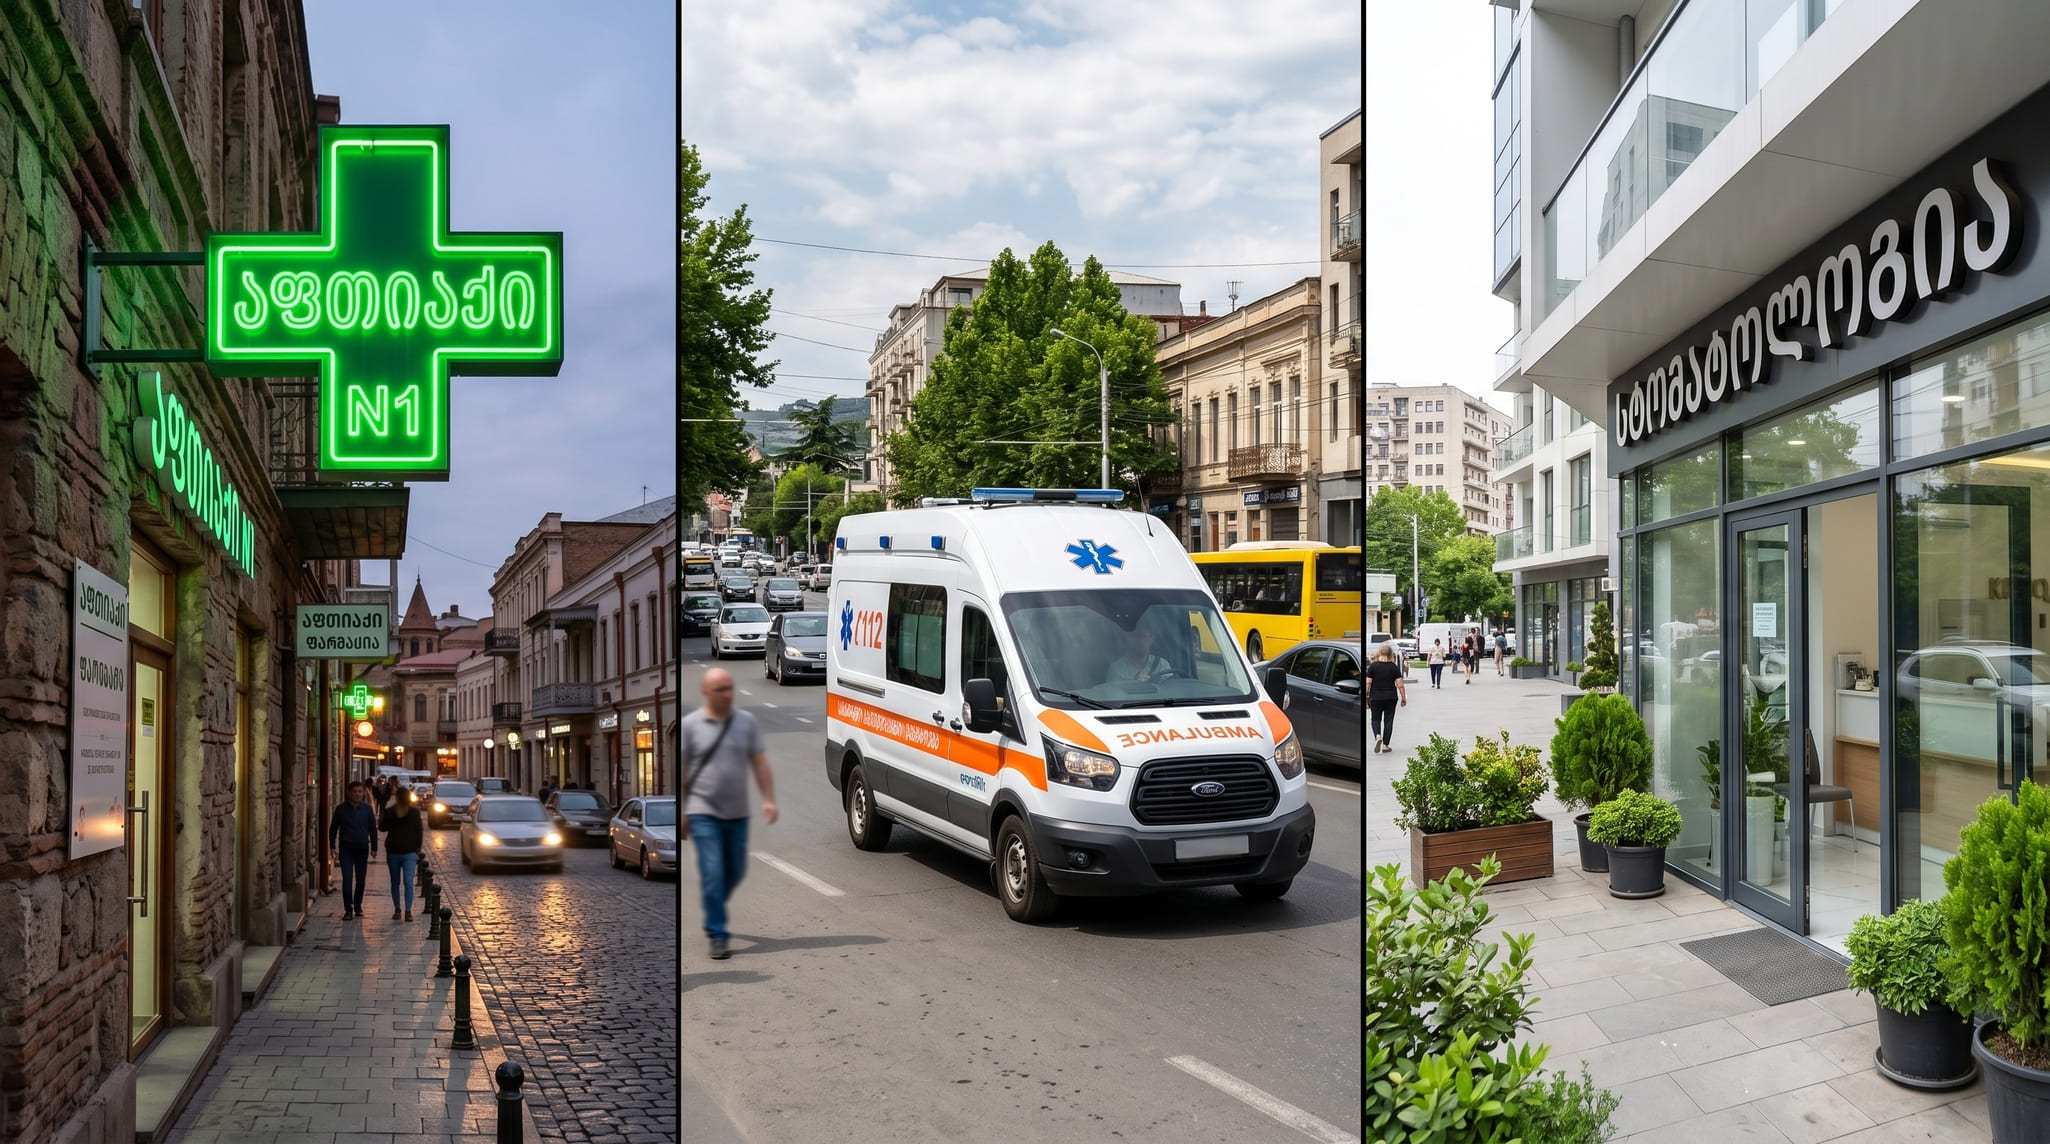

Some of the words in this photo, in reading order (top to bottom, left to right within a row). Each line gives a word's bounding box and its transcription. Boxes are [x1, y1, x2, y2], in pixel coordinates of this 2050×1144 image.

[233, 265, 536, 330] აფთიაქი
[1615, 157, 2011, 448] სტომატოლოგია
[347, 384, 420, 437] N1
[151, 370, 240, 561] აფთიაქი
[79, 582, 126, 630] აფთიაქი
[302, 612, 382, 628] აფთიაქი
